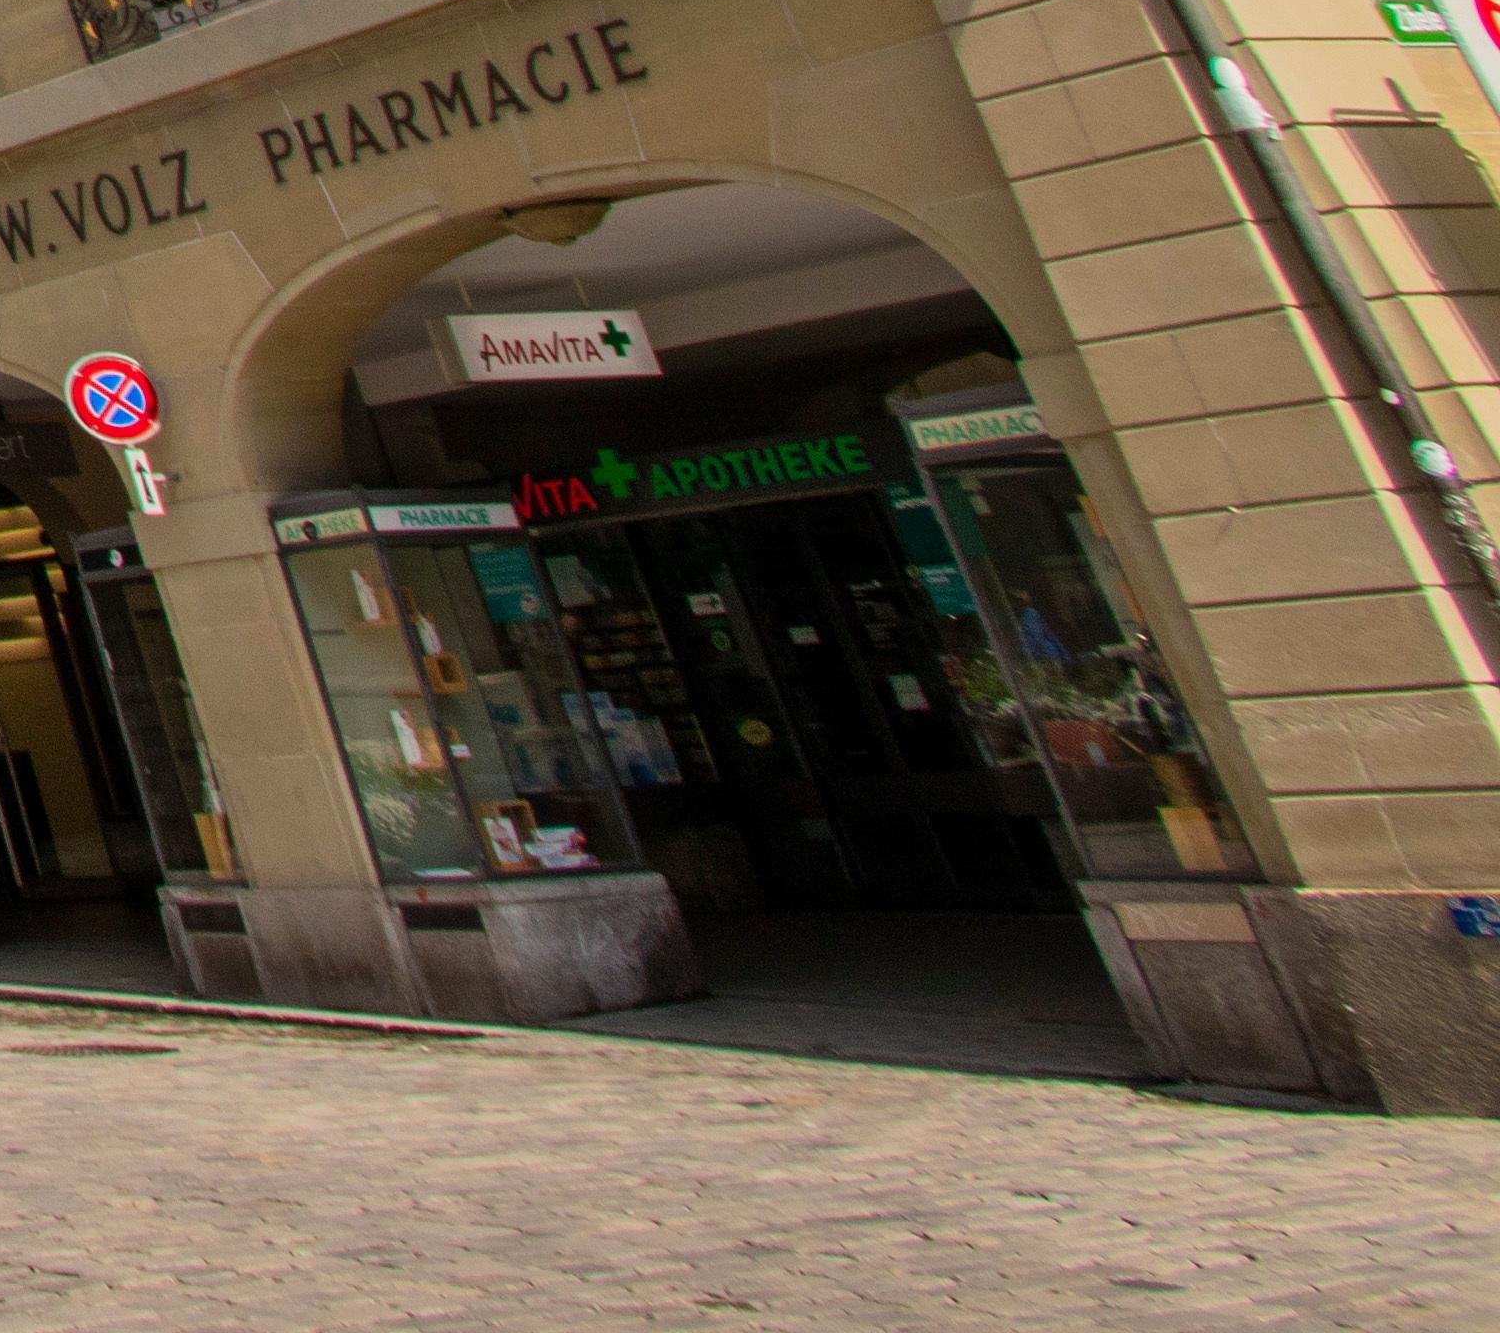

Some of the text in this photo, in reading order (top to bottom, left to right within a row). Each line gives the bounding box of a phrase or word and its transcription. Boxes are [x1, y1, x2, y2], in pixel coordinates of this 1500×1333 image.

[258, 18, 650, 186] PHARMACIE
[921, 411, 1042, 446] PHARMAC
[648, 435, 871, 501] APOTHEKE
